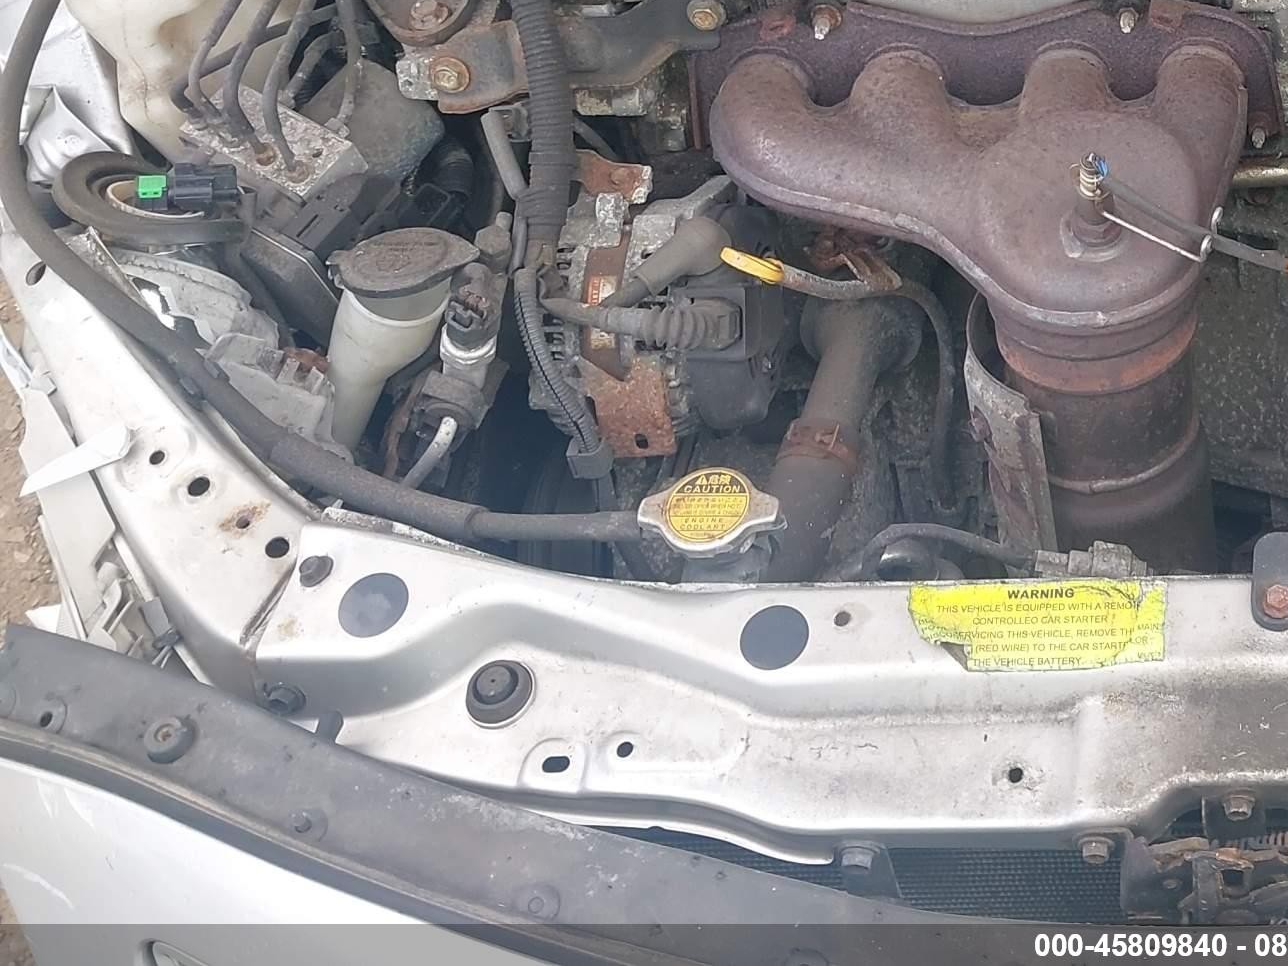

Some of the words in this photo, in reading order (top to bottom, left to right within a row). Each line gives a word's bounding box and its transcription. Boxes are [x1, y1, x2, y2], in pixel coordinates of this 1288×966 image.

[683, 485, 741, 493] CAUTION
[1007, 588, 1075, 600] WARNING
[936, 605, 959, 614] THIS
[961, 604, 1001, 613] VEHICLE
[1004, 603, 1013, 612] IS
[1015, 603, 1065, 612] EQUIPPED
[1068, 602, 1092, 611] WITH
[1094, 602, 1101, 611] A
[1040, 616, 1060, 624] CAR
[1063, 615, 1108, 624] STARTER
[1007, 630, 1028, 639] THIS
[1030, 630, 1073, 639] VEHICLE,
[1076, 629, 1117, 637] REMOVE
[975, 643, 999, 653] (RED
[1001, 643, 1030, 653] WIRE)
[1032, 643, 1046, 651] TO
[1049, 643, 1067, 651] THE
[1069, 642, 1089, 651] CAR
[973, 658, 991, 666] THE
[994, 658, 1036, 666] VEHICLE
